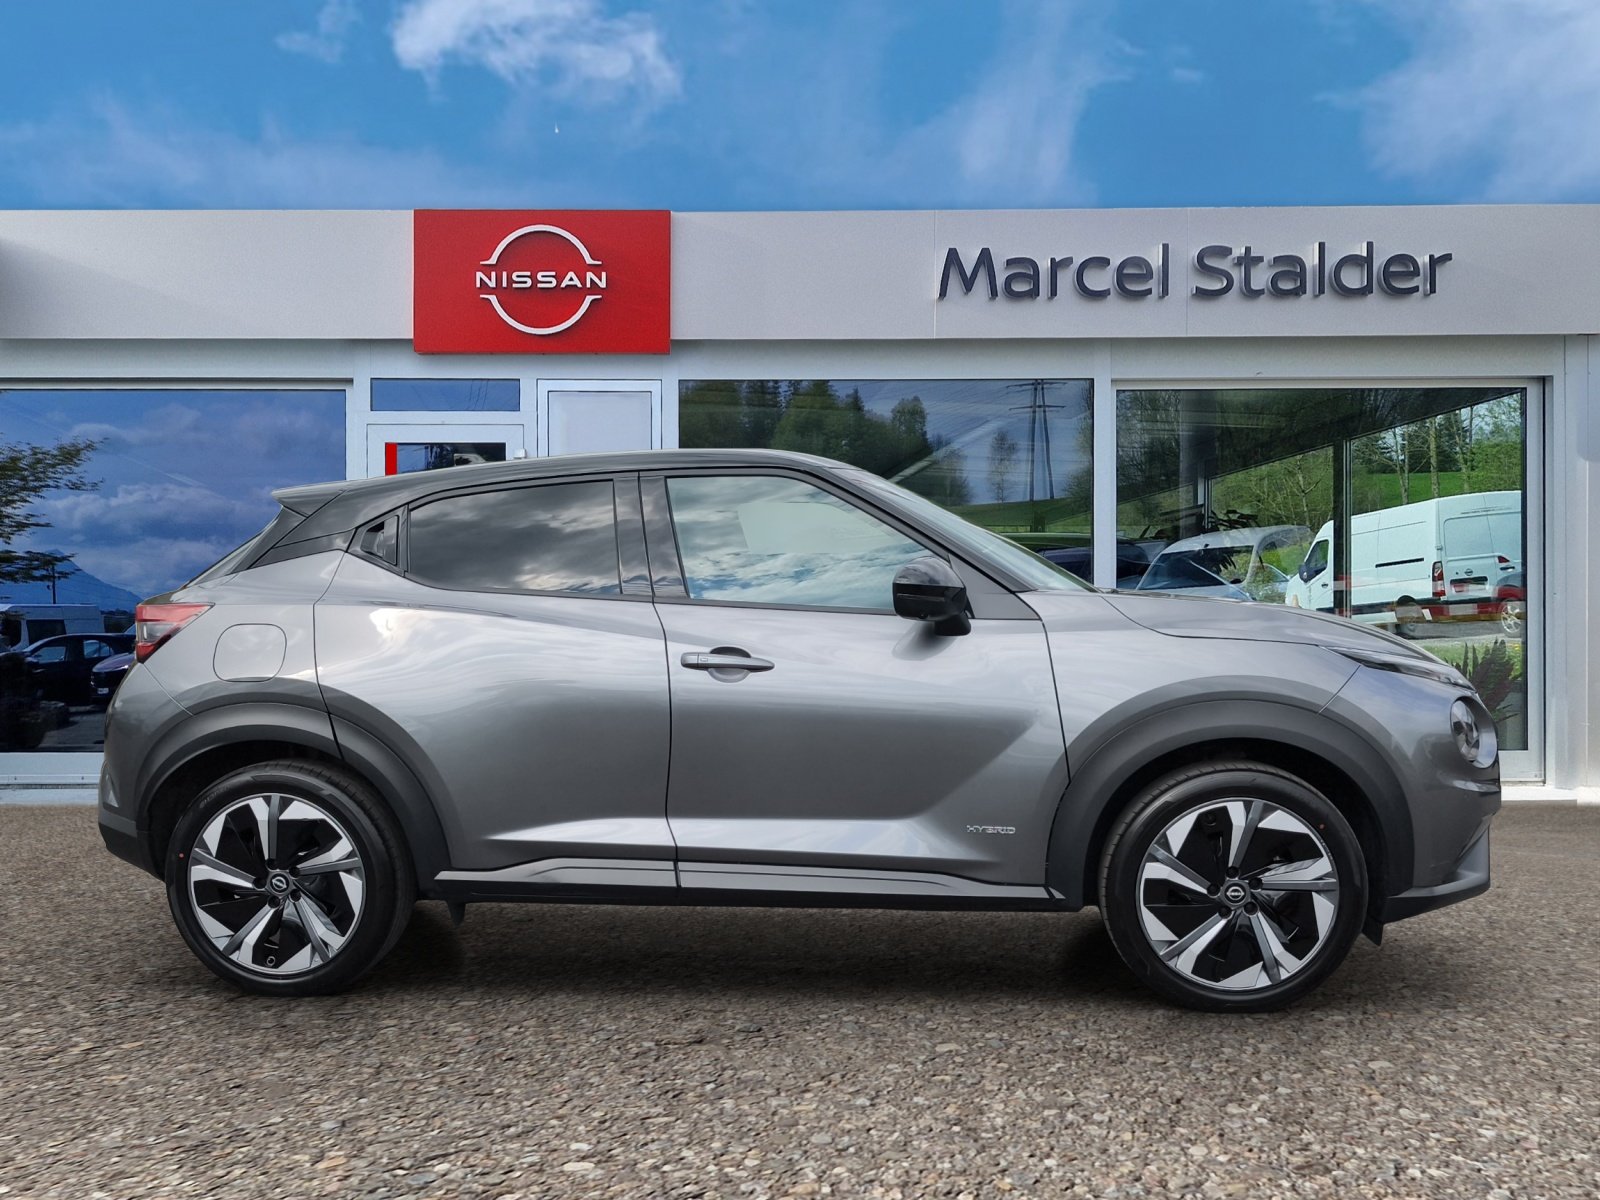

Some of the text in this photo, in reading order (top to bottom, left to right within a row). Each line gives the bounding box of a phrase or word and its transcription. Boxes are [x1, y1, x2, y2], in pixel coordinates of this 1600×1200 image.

[937, 240, 1453, 300] Marcel Stalder
[475, 271, 607, 289] NISSAN
[966, 825, 1016, 834] HYBRID
